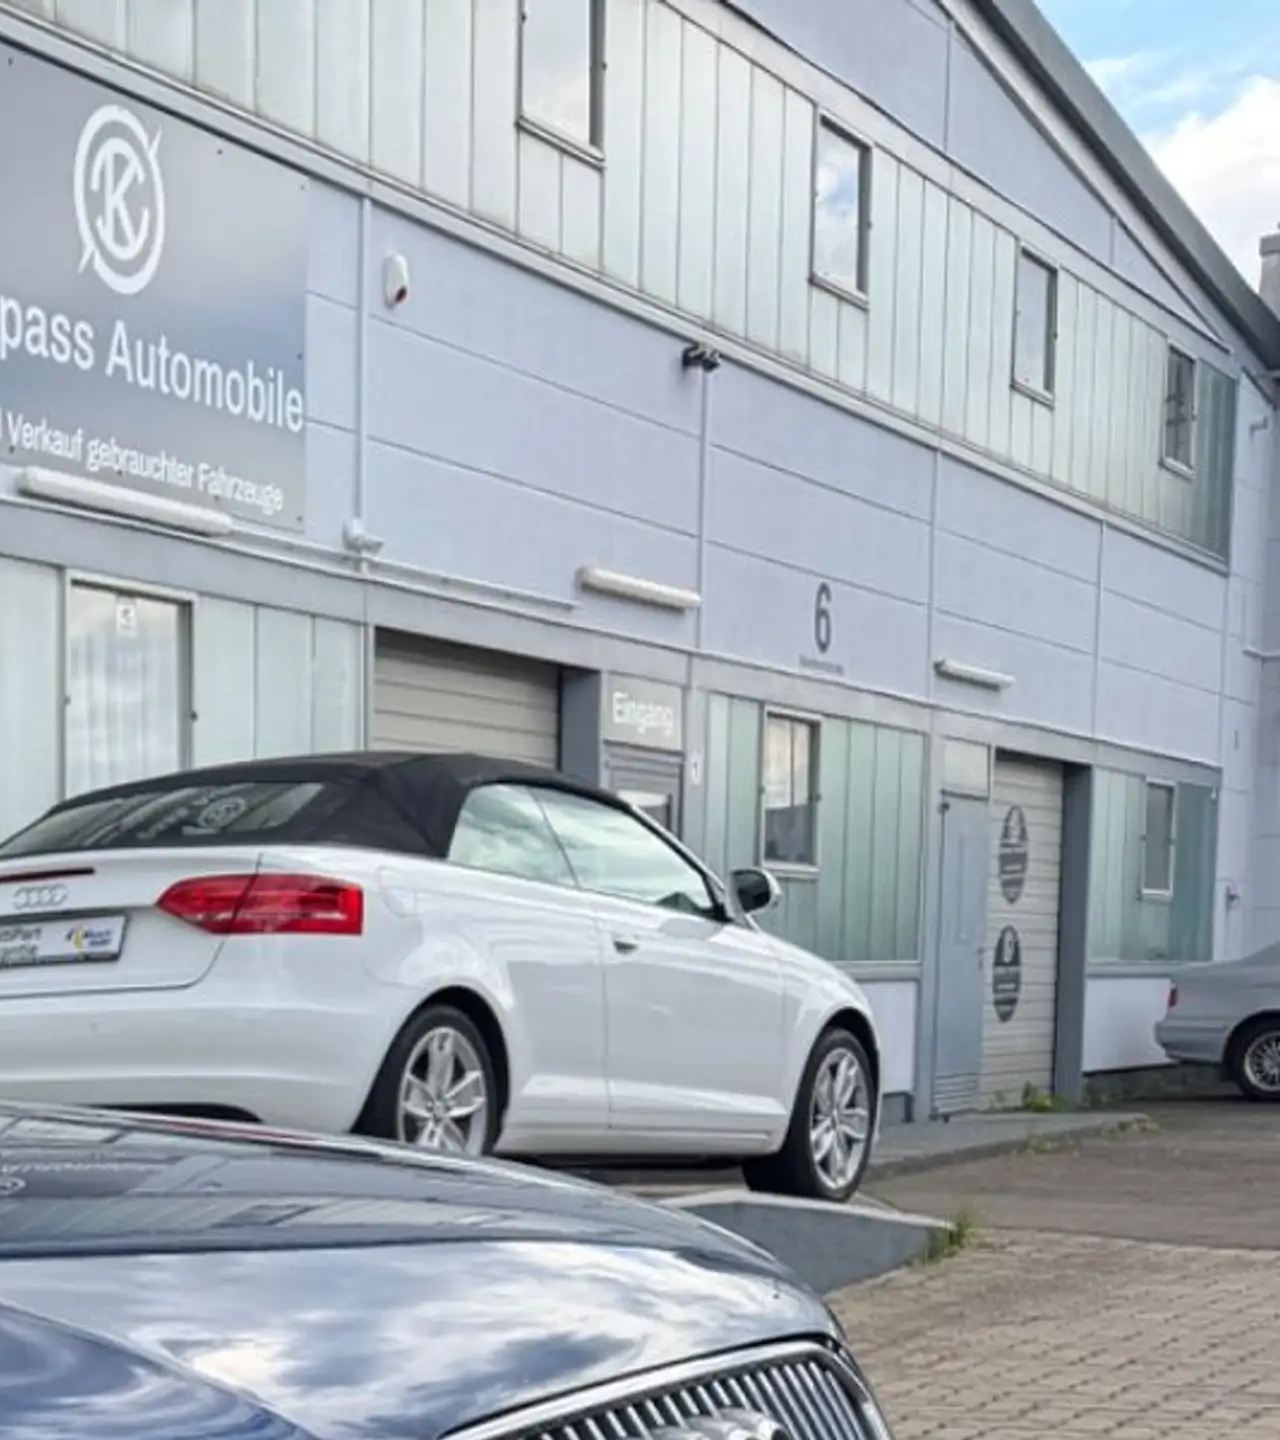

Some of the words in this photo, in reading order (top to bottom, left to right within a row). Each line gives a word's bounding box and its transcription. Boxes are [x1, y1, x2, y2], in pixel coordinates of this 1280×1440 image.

[105, 320, 304, 433] Automobile
[6, 411, 84, 462] Verkauf
[87, 433, 195, 488] gebrauchter
[197, 462, 284, 516] Fahrzeuge
[814, 581, 832, 654] 6
